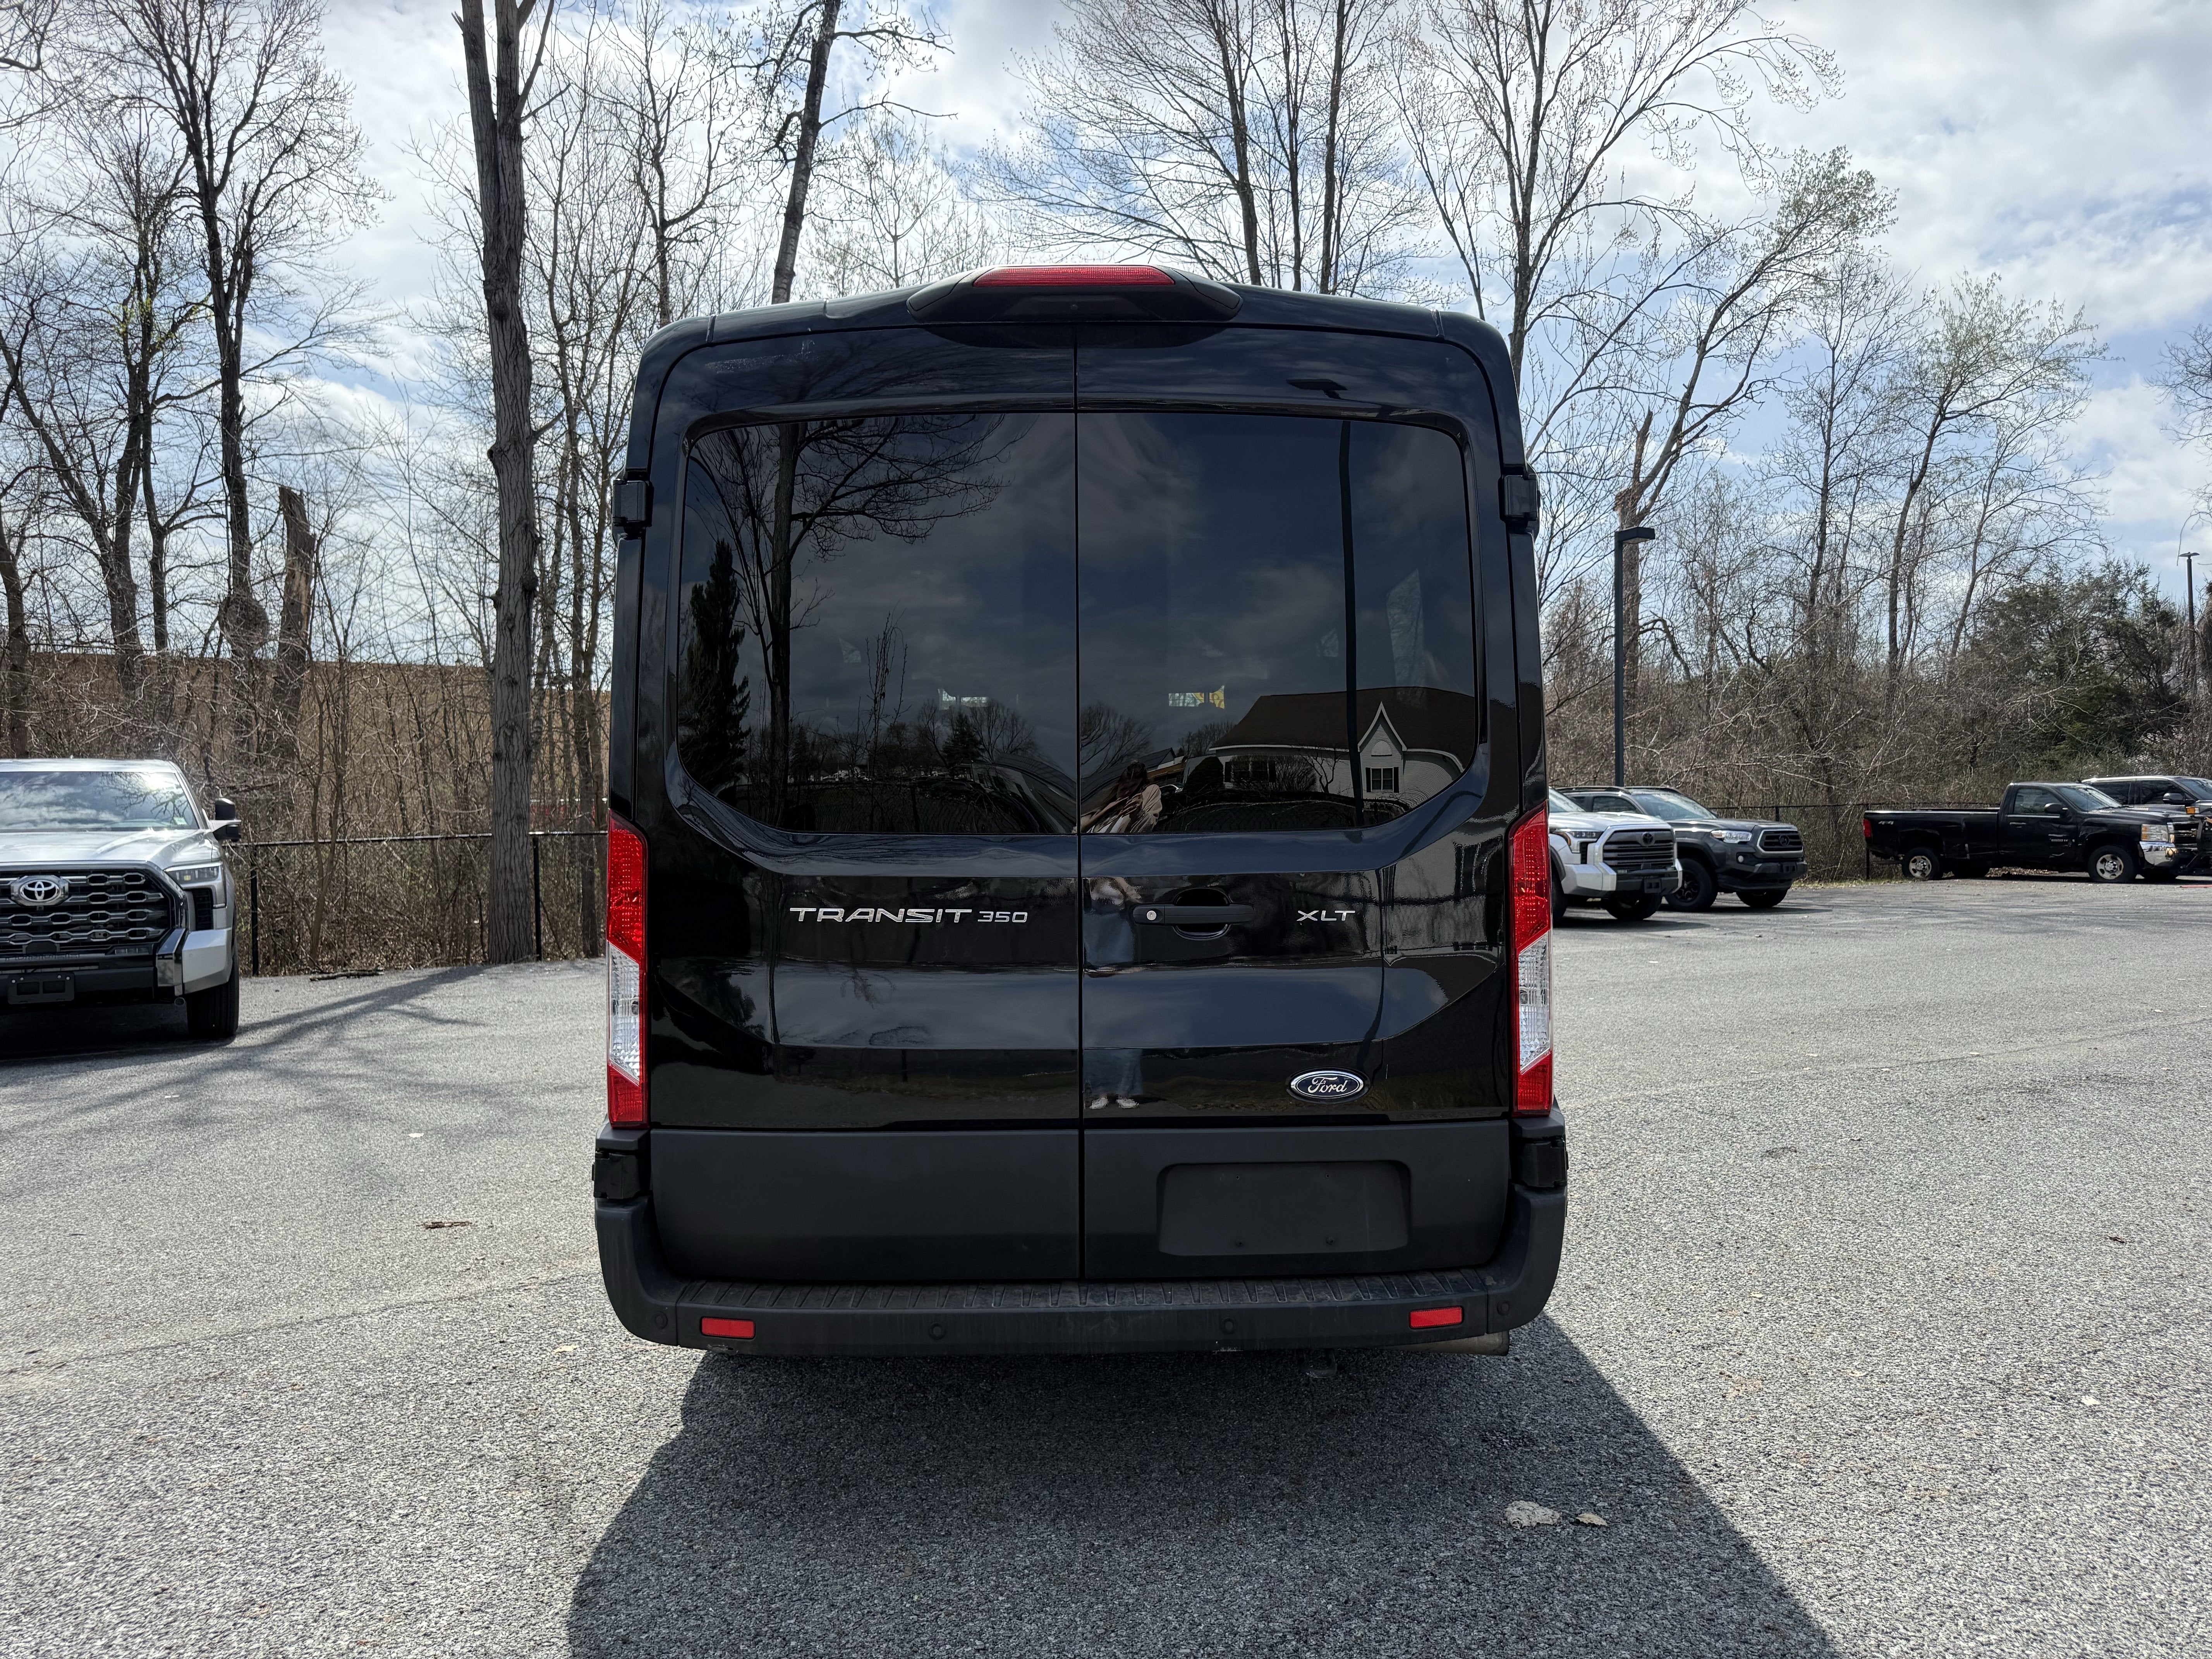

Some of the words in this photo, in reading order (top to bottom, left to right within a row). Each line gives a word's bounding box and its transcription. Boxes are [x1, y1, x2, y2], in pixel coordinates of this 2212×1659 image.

[790, 908, 972, 923] TRANSIT
[977, 911, 1028, 923] 350
[1297, 910, 1355, 921] XLT
[1307, 1077, 1348, 1093] Ford
